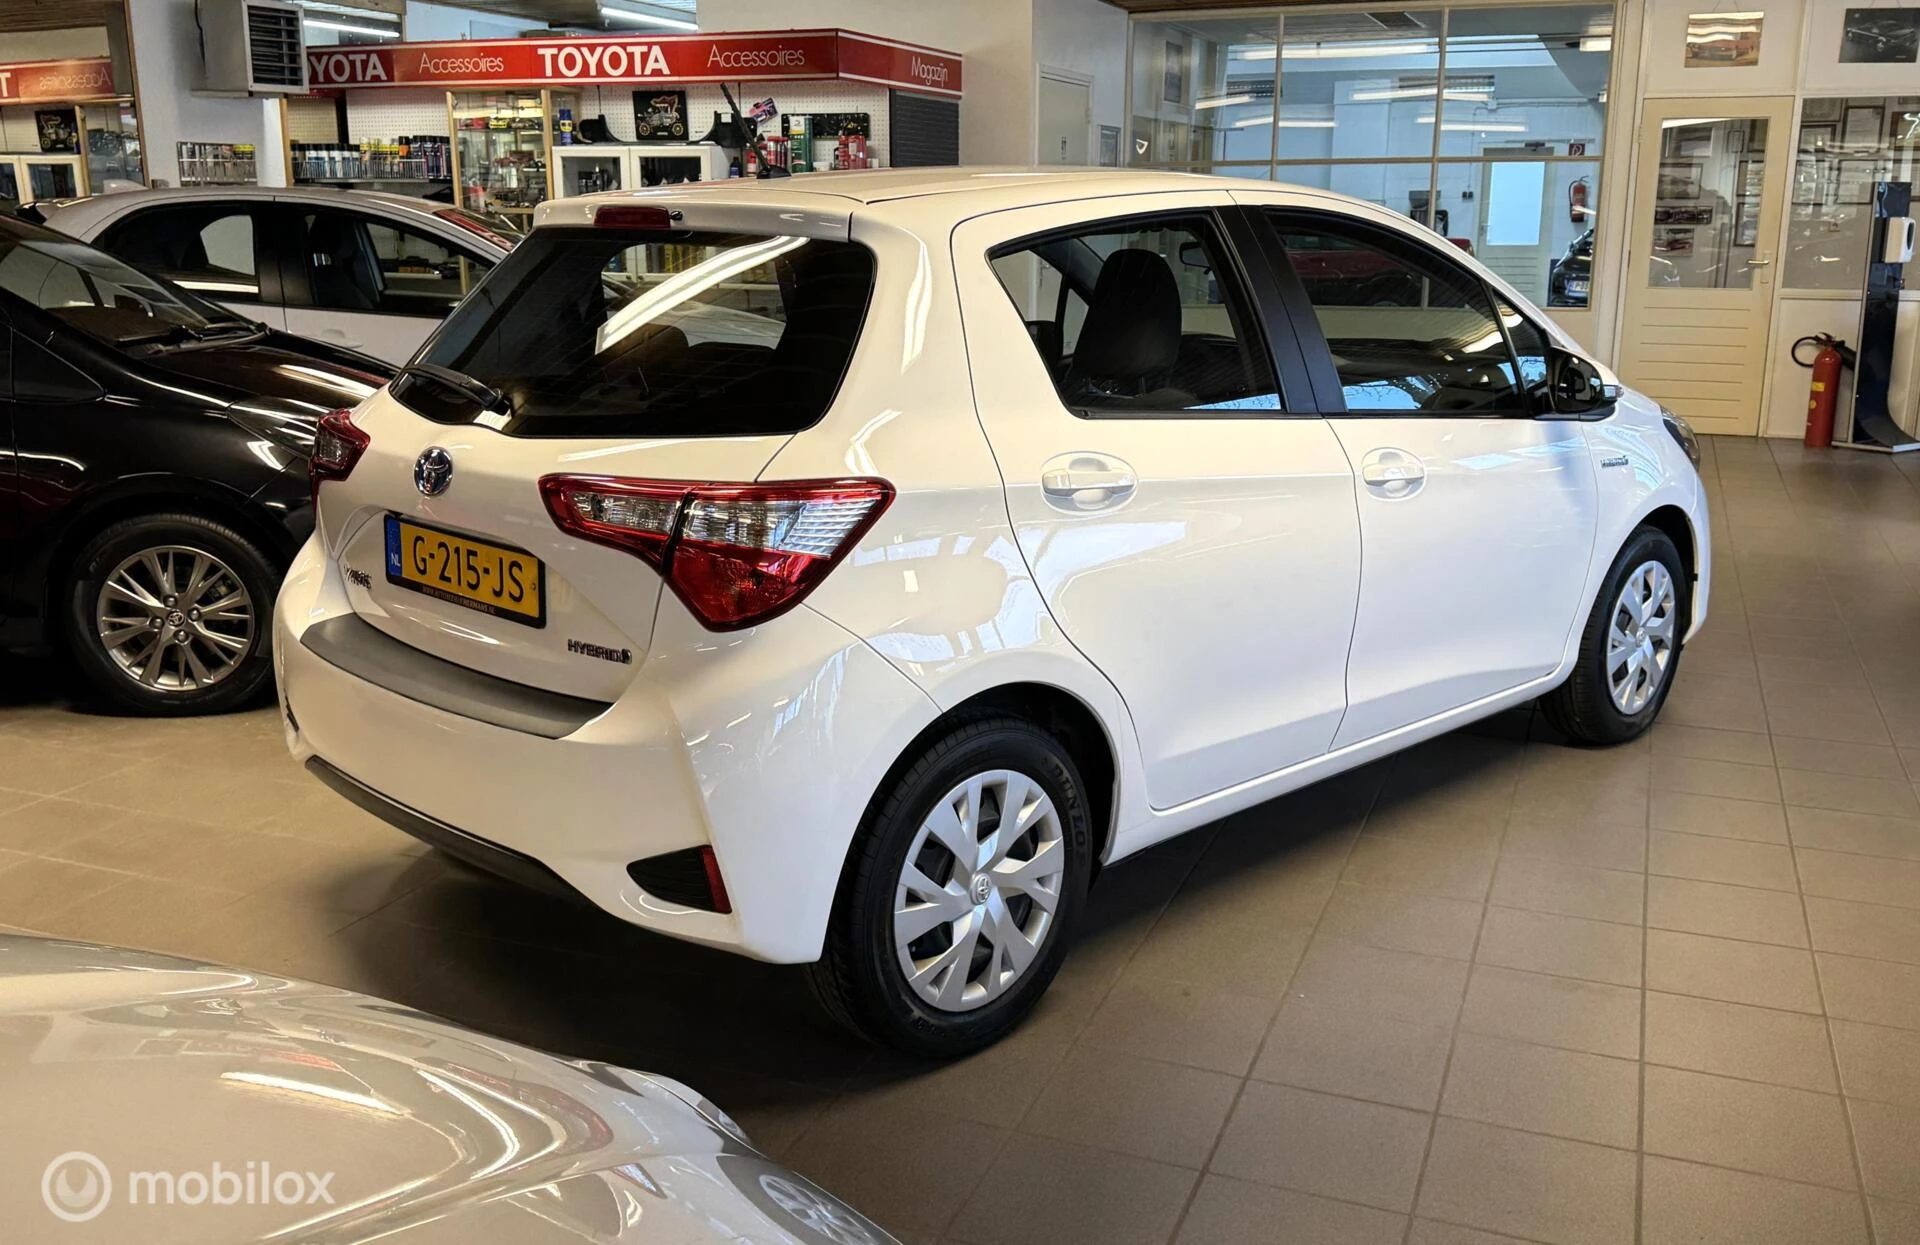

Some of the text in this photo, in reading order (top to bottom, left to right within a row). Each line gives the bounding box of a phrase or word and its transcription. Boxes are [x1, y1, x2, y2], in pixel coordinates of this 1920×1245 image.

[308, 44, 805, 82] YOTA Accessoires TOYOTA Accessoires
[911, 56, 948, 88] Magazijn
[391, 553, 401, 566] NL
[413, 536, 524, 602] G-215-JS
